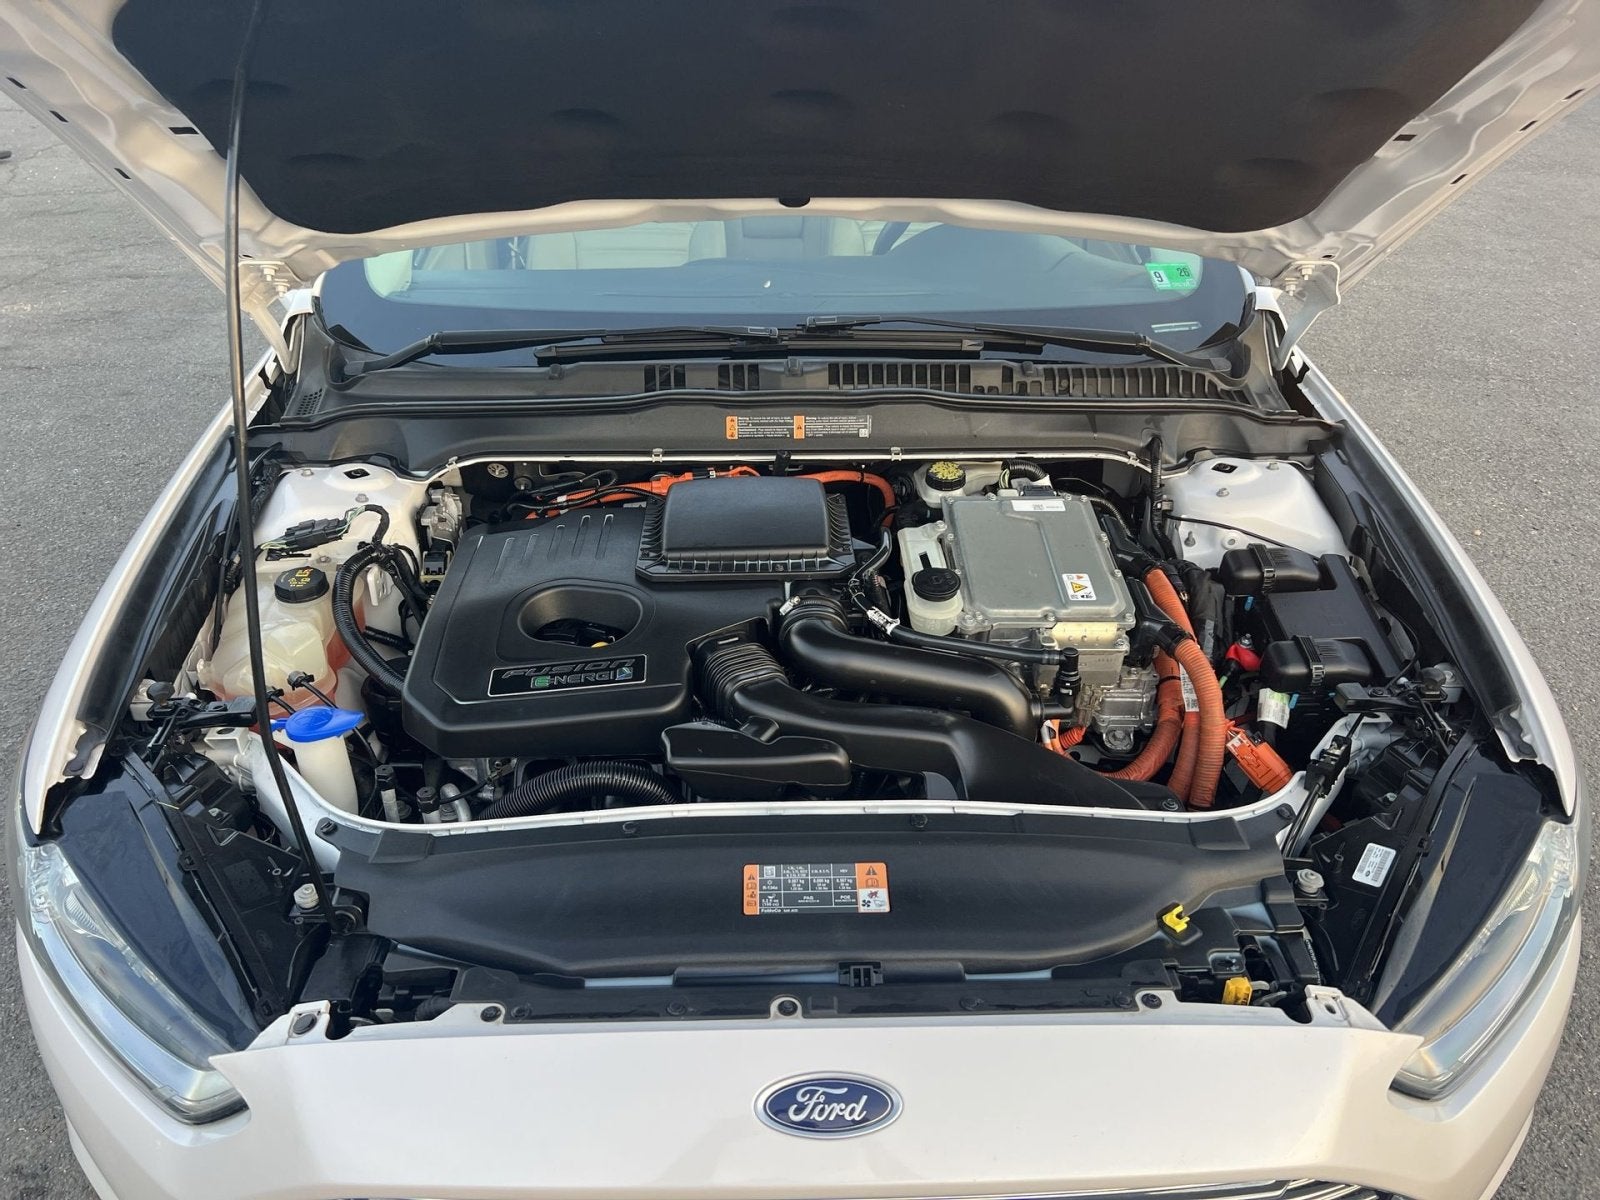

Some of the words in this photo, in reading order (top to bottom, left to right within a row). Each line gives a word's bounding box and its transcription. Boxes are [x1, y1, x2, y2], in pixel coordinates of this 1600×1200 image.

[1153, 271, 1163, 283] 9
[1176, 267, 1190, 277] 26
[501, 658, 635, 679] FUSION
[788, 1086, 868, 1122] Ford
